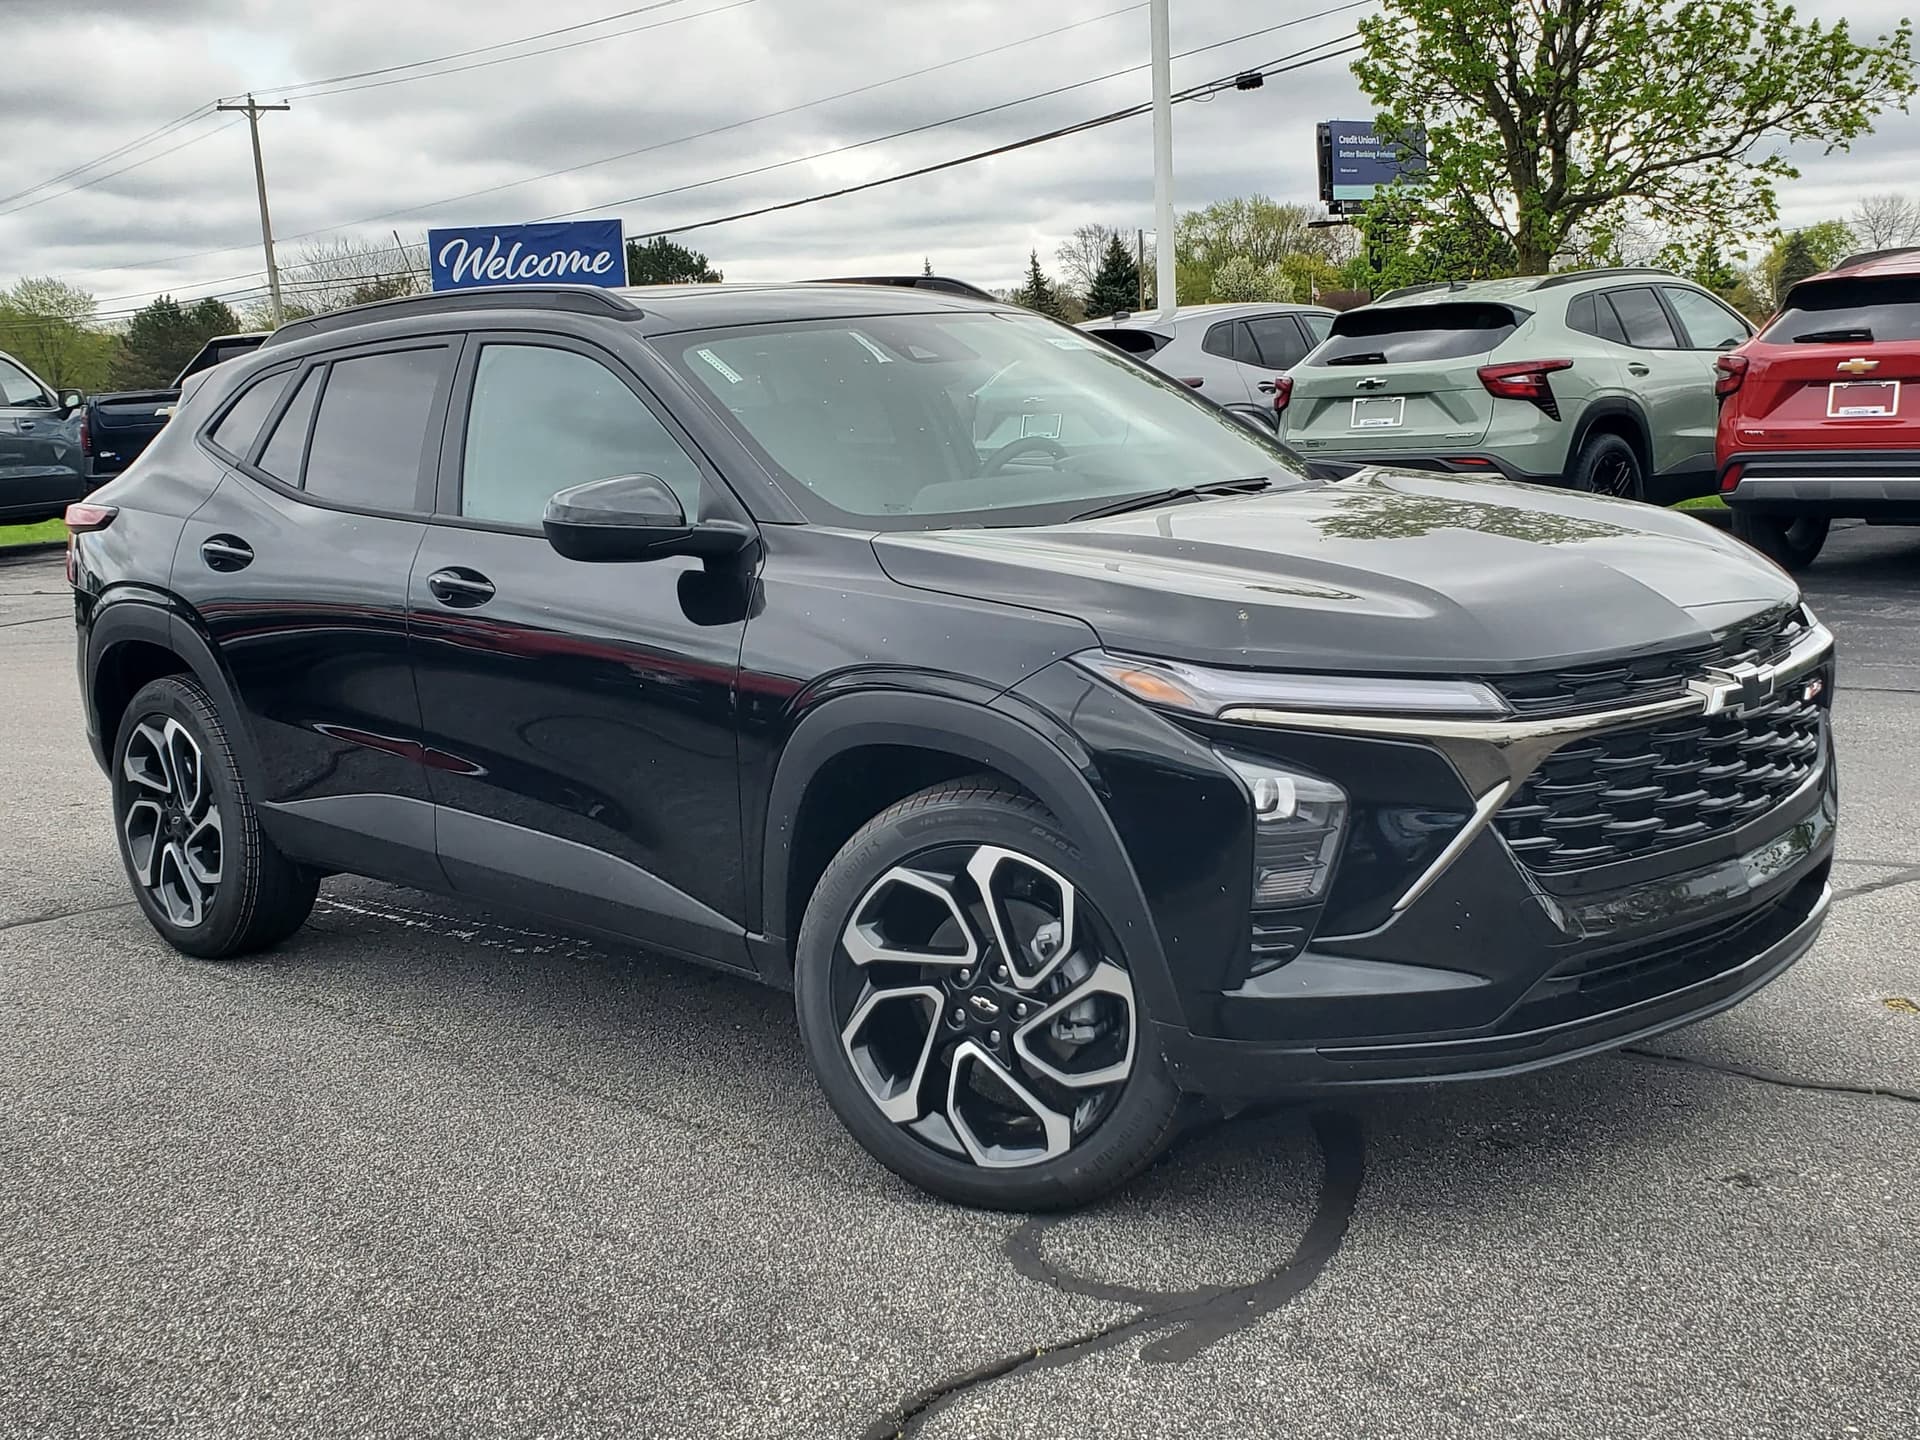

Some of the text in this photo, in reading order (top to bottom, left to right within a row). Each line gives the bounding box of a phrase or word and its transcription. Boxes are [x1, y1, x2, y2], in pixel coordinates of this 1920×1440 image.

[1339, 135, 1358, 145] Credit
[1358, 135, 1377, 145] Union
[439, 235, 615, 283] Welcome
